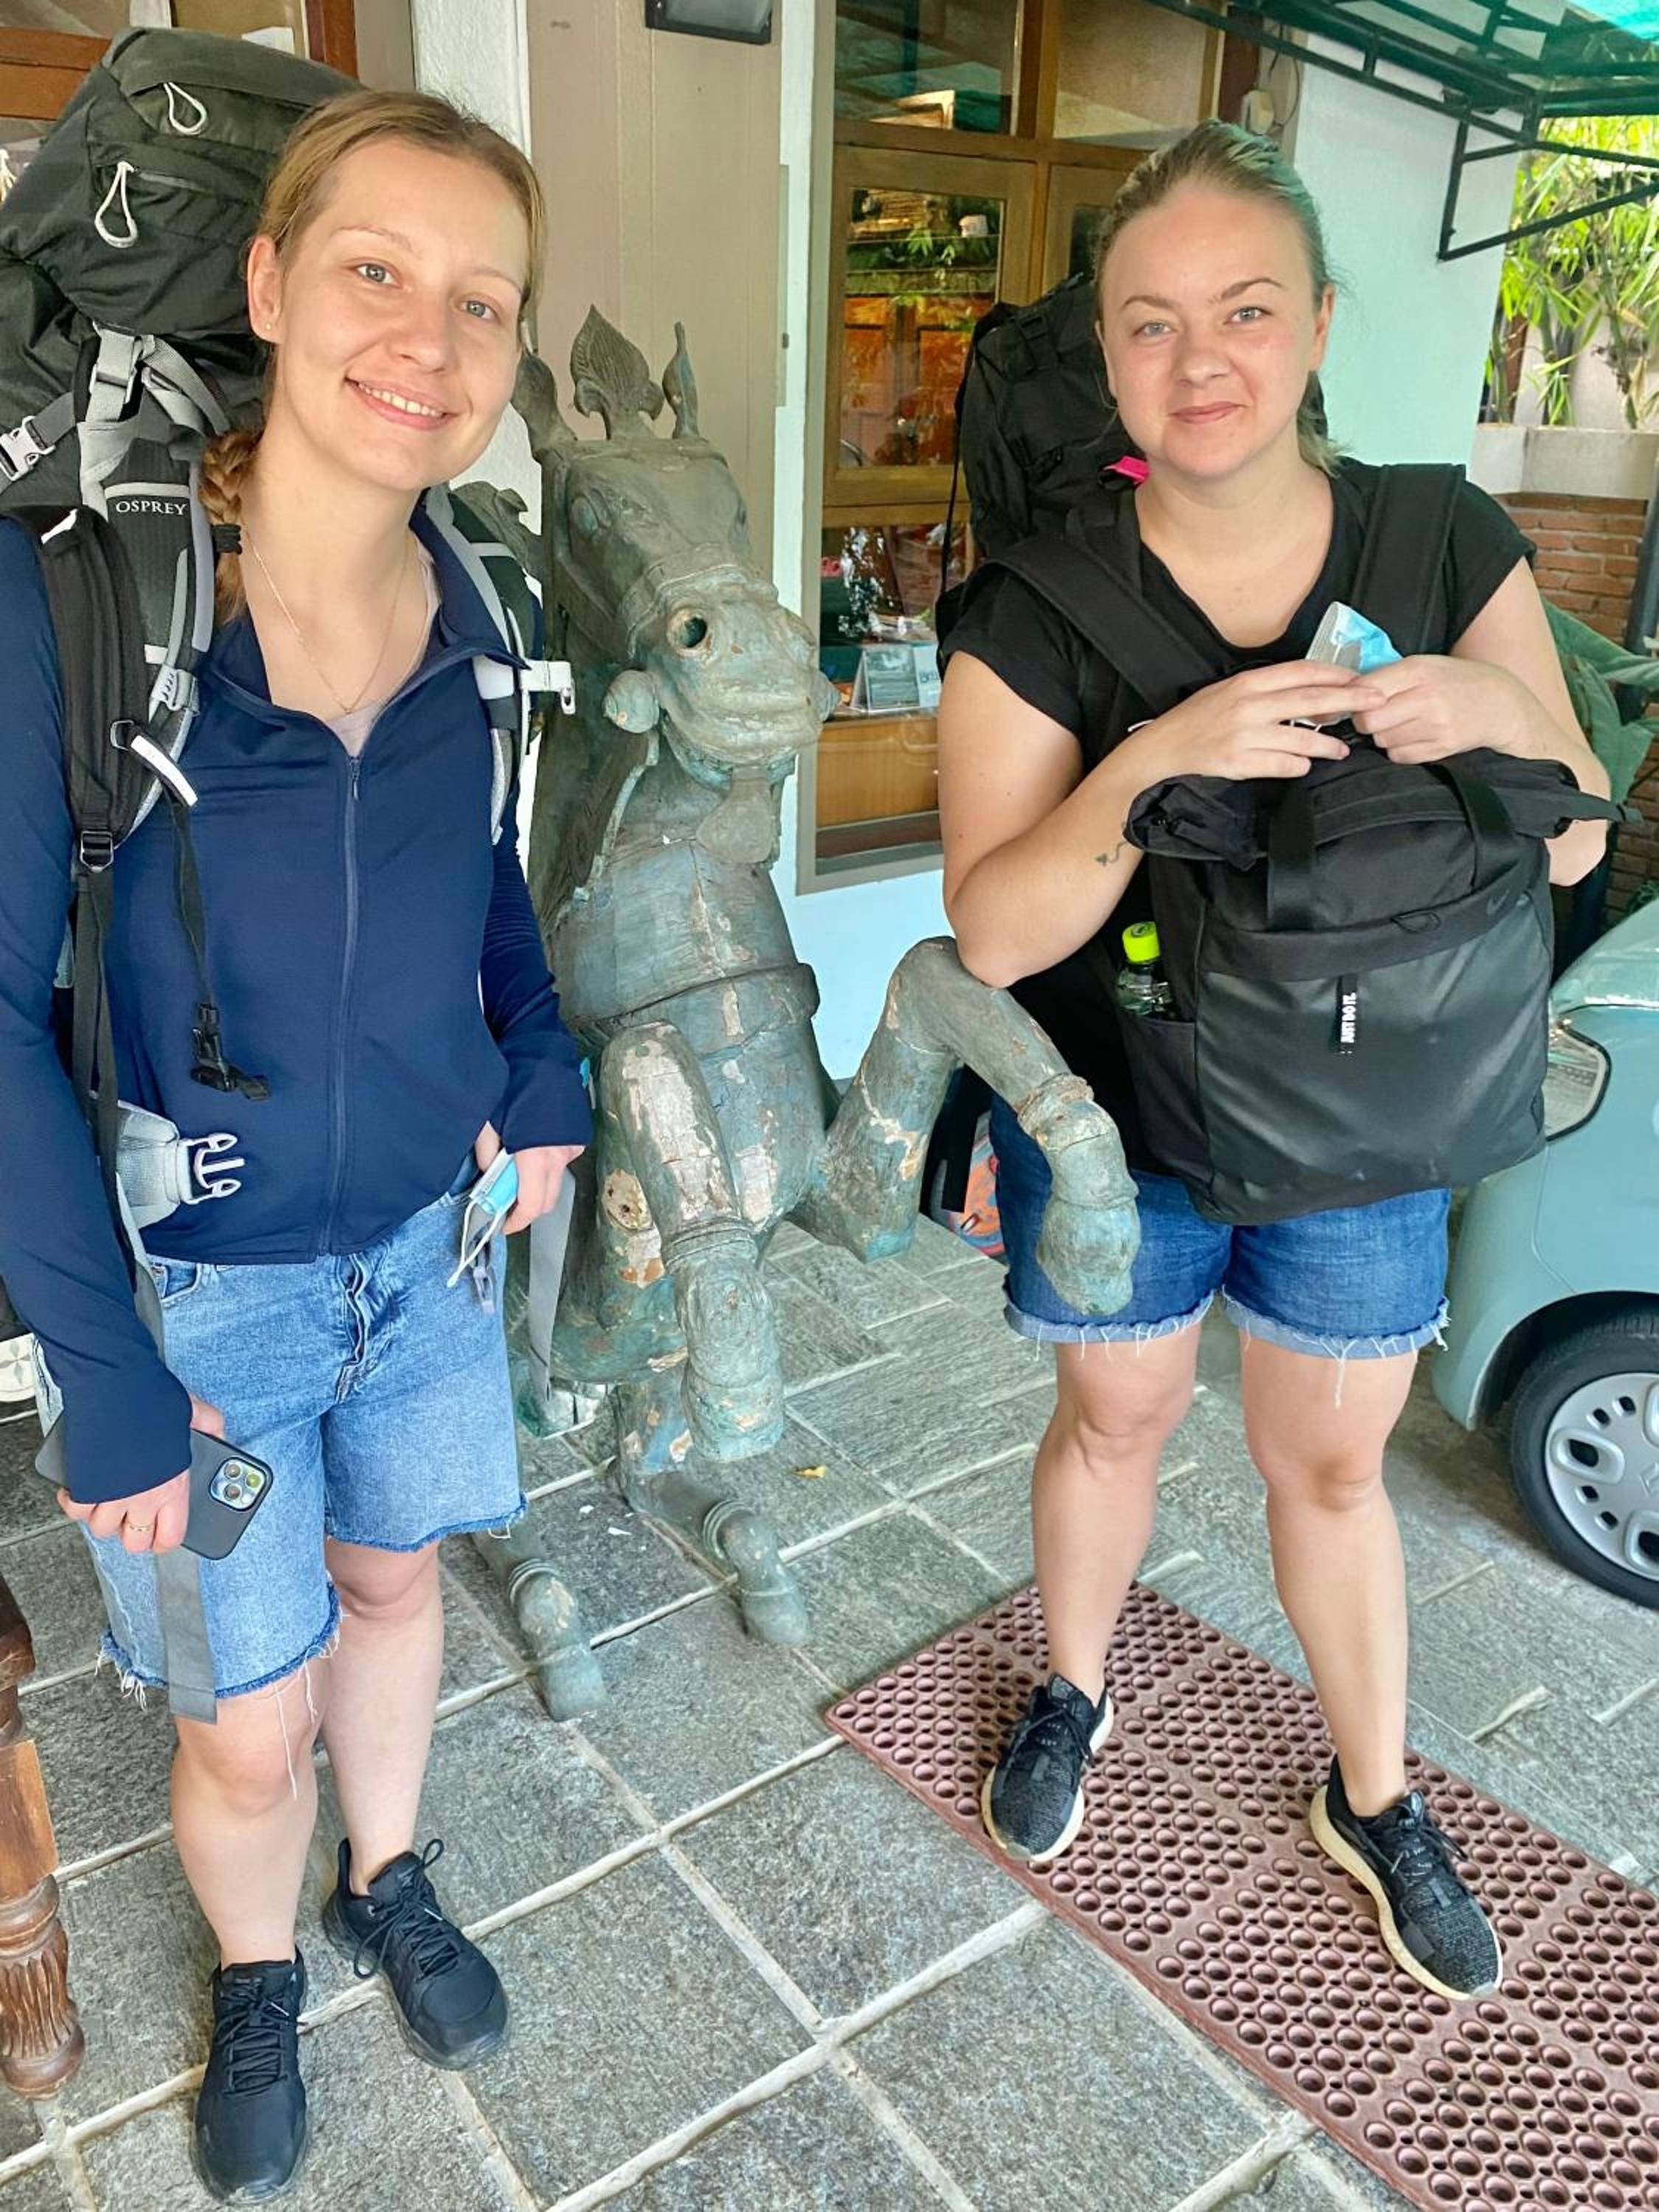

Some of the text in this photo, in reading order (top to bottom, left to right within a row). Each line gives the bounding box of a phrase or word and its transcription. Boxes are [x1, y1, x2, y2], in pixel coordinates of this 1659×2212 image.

[116, 500, 187, 515] OSPREY
[1342, 1005, 1356, 1021] DO
[1340, 1022, 1355, 1043] JUST
